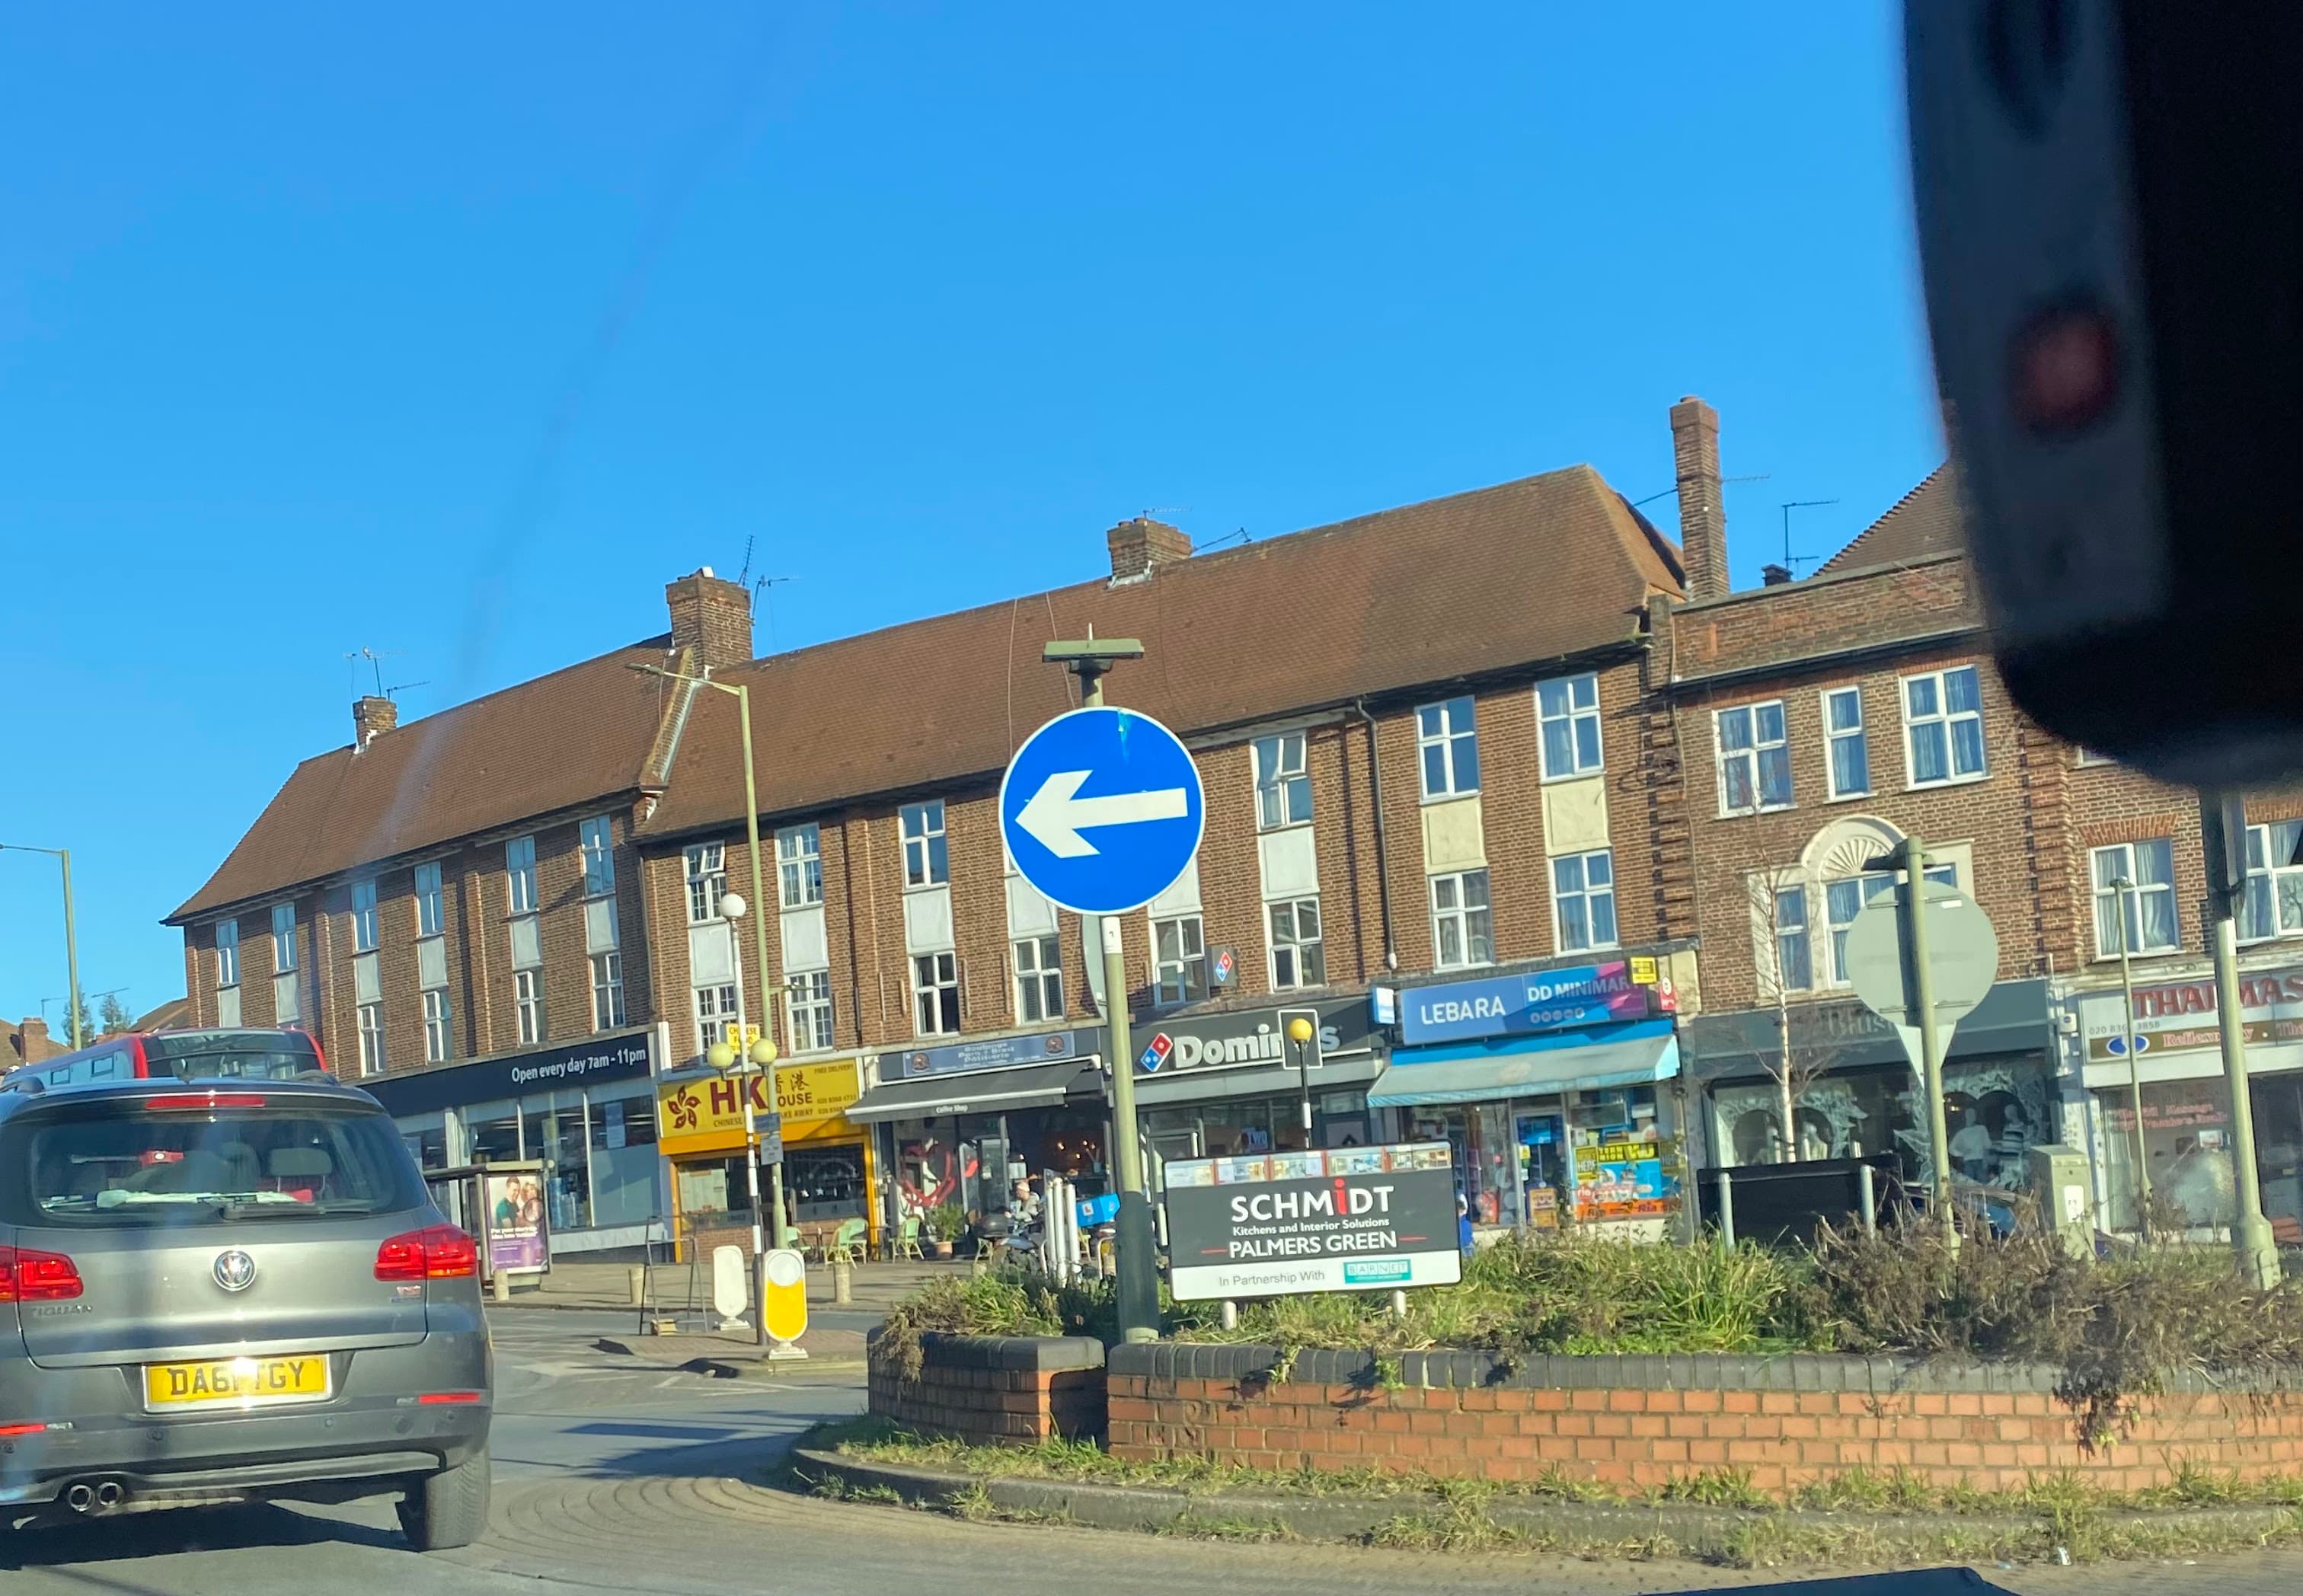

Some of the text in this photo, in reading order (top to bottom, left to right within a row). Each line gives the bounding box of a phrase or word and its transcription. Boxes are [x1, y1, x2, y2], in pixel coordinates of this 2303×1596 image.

[1528, 985, 1553, 1002] DD
[1554, 977, 1639, 998] MINIMAR
[1420, 995, 1506, 1025] LEBARA
[2132, 985, 2217, 1019] THAI
[2089, 1026, 2107, 1035] 020
[2110, 1024, 2128, 1033] 836
[511, 1067, 538, 1084] Open
[539, 1062, 566, 1077] every
[567, 1057, 586, 1074] day
[587, 1055, 609, 1070] 7am
[617, 1048, 647, 1065] 11pm
[710, 1074, 768, 1115] HK
[777, 1092, 813, 1106] OUSE
[714, 1116, 743, 1128] CHINESE
[794, 1108, 813, 1118] AWAY
[1232, 1217, 1390, 1237] Kitchens and Interior Solutions
[1228, 1231, 1397, 1259] PALMERS GREEN
[1219, 1269, 1325, 1287] In Partnership With
[1349, 1262, 1407, 1275] BARNET
